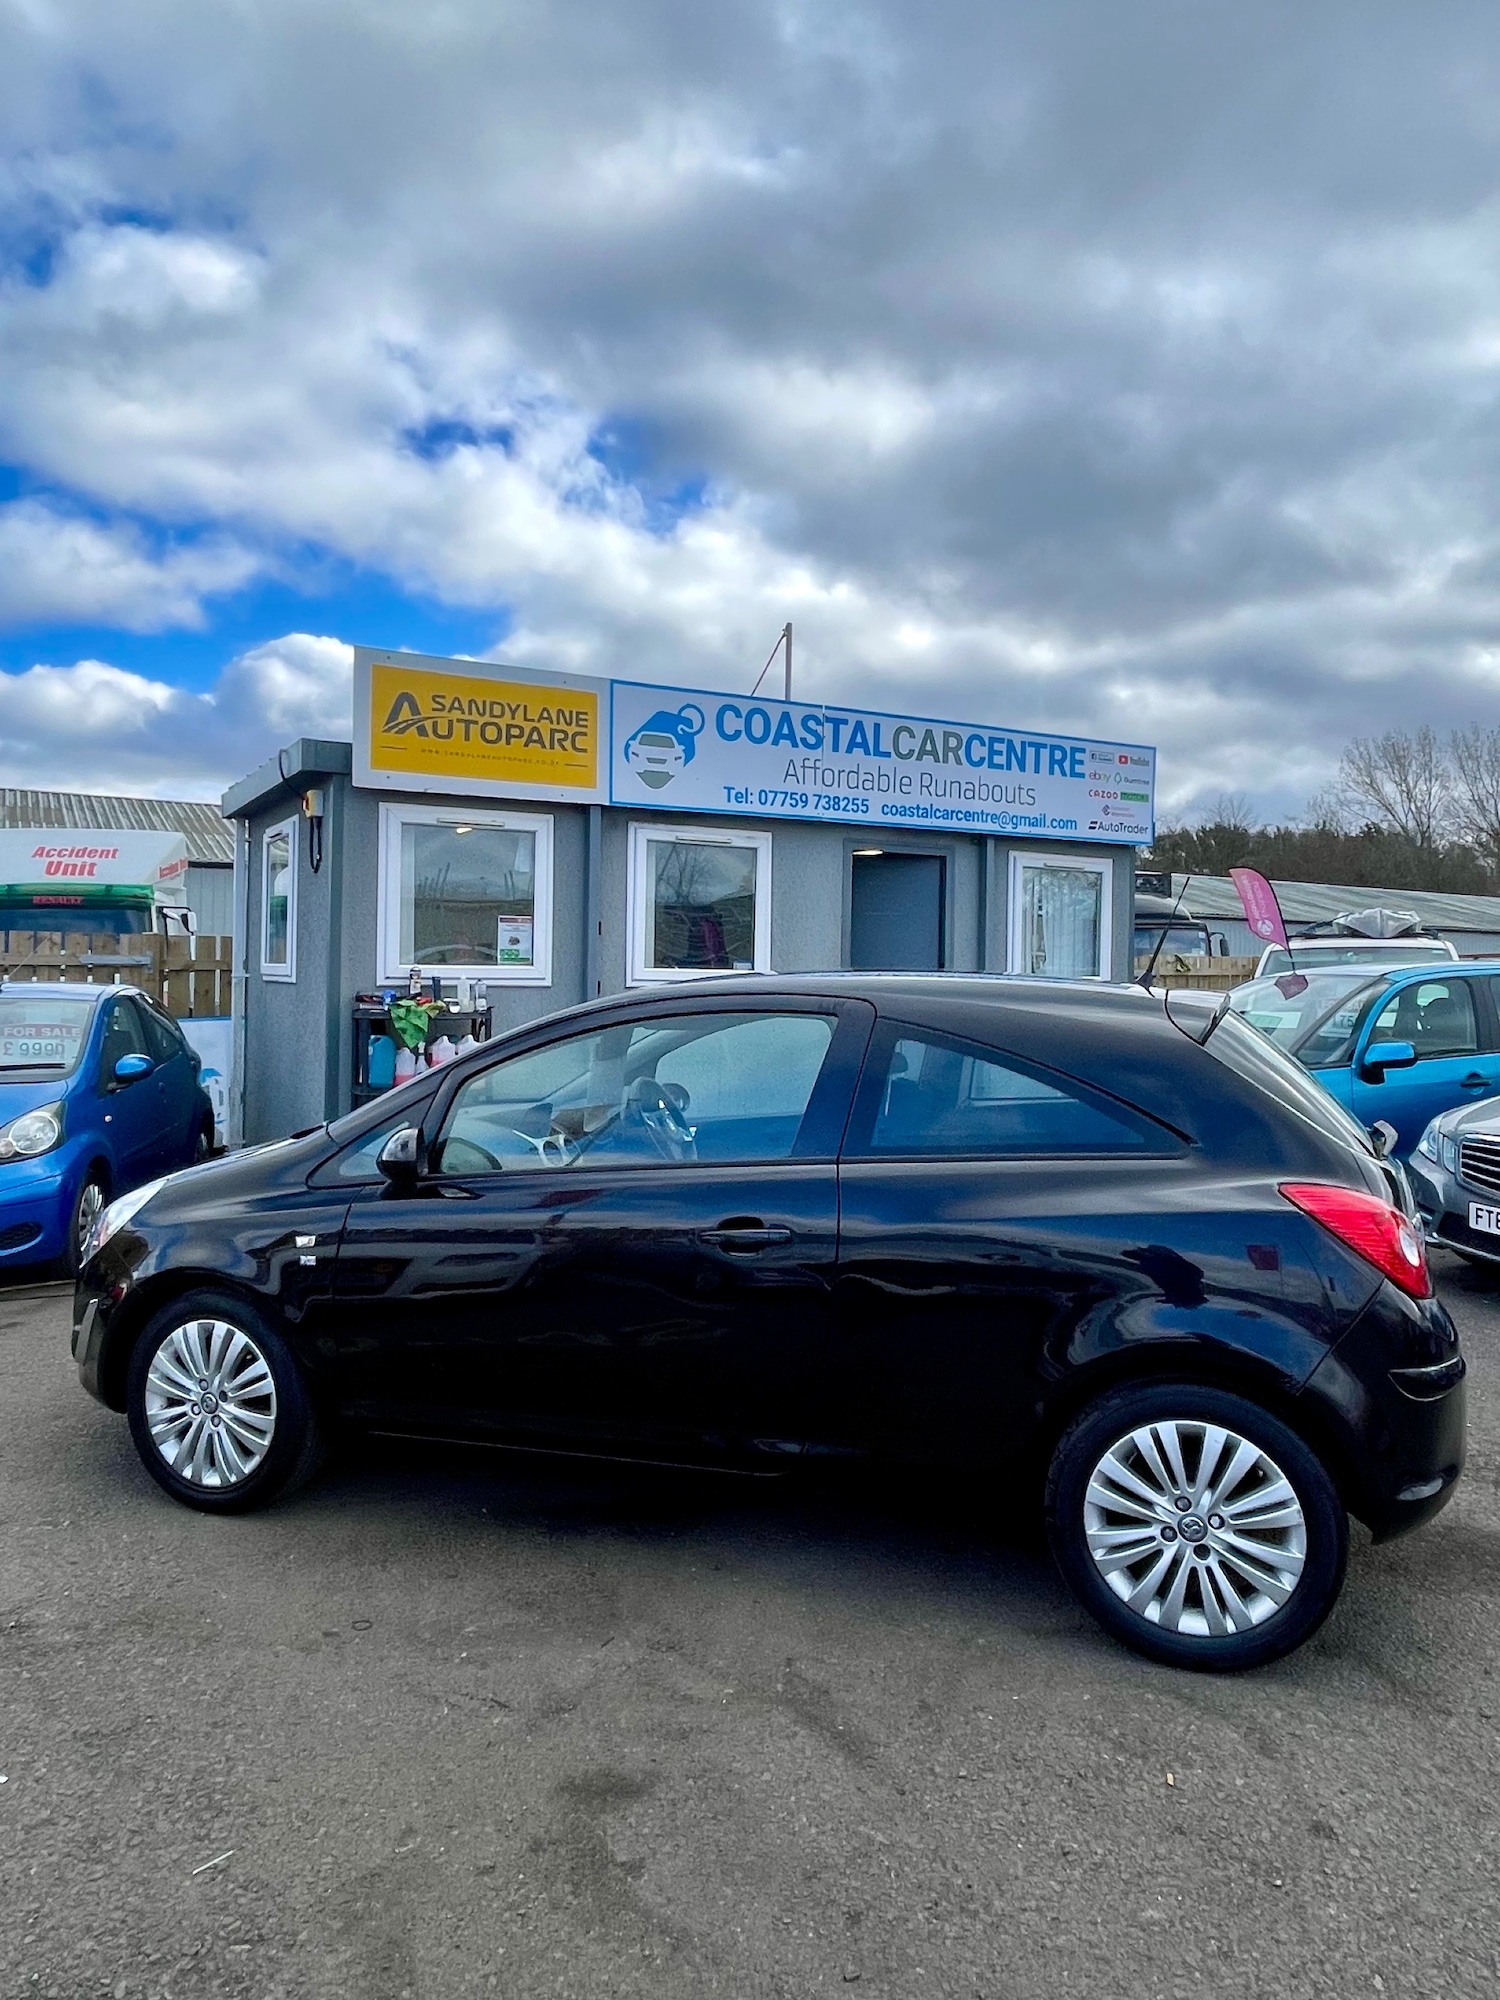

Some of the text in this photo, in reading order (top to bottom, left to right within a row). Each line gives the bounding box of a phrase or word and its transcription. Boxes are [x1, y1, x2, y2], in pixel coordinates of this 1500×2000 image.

[382, 692, 589, 753] AUTOPARC
[431, 694, 589, 729] SANDYLANE
[715, 704, 1086, 780] COASTALCARCENTRE
[783, 757, 1036, 806] Affordable Runabouts
[1089, 770, 1111, 783] ebay
[723, 786, 1078, 831] Tel: 07759 738255 coastalcarcentre@gmail.com
[1098, 821, 1149, 835] AutoTrader
[31, 846, 119, 859] Accident
[45, 860, 98, 877] Unit
[4, 1026, 81, 1037] FOR SALE
